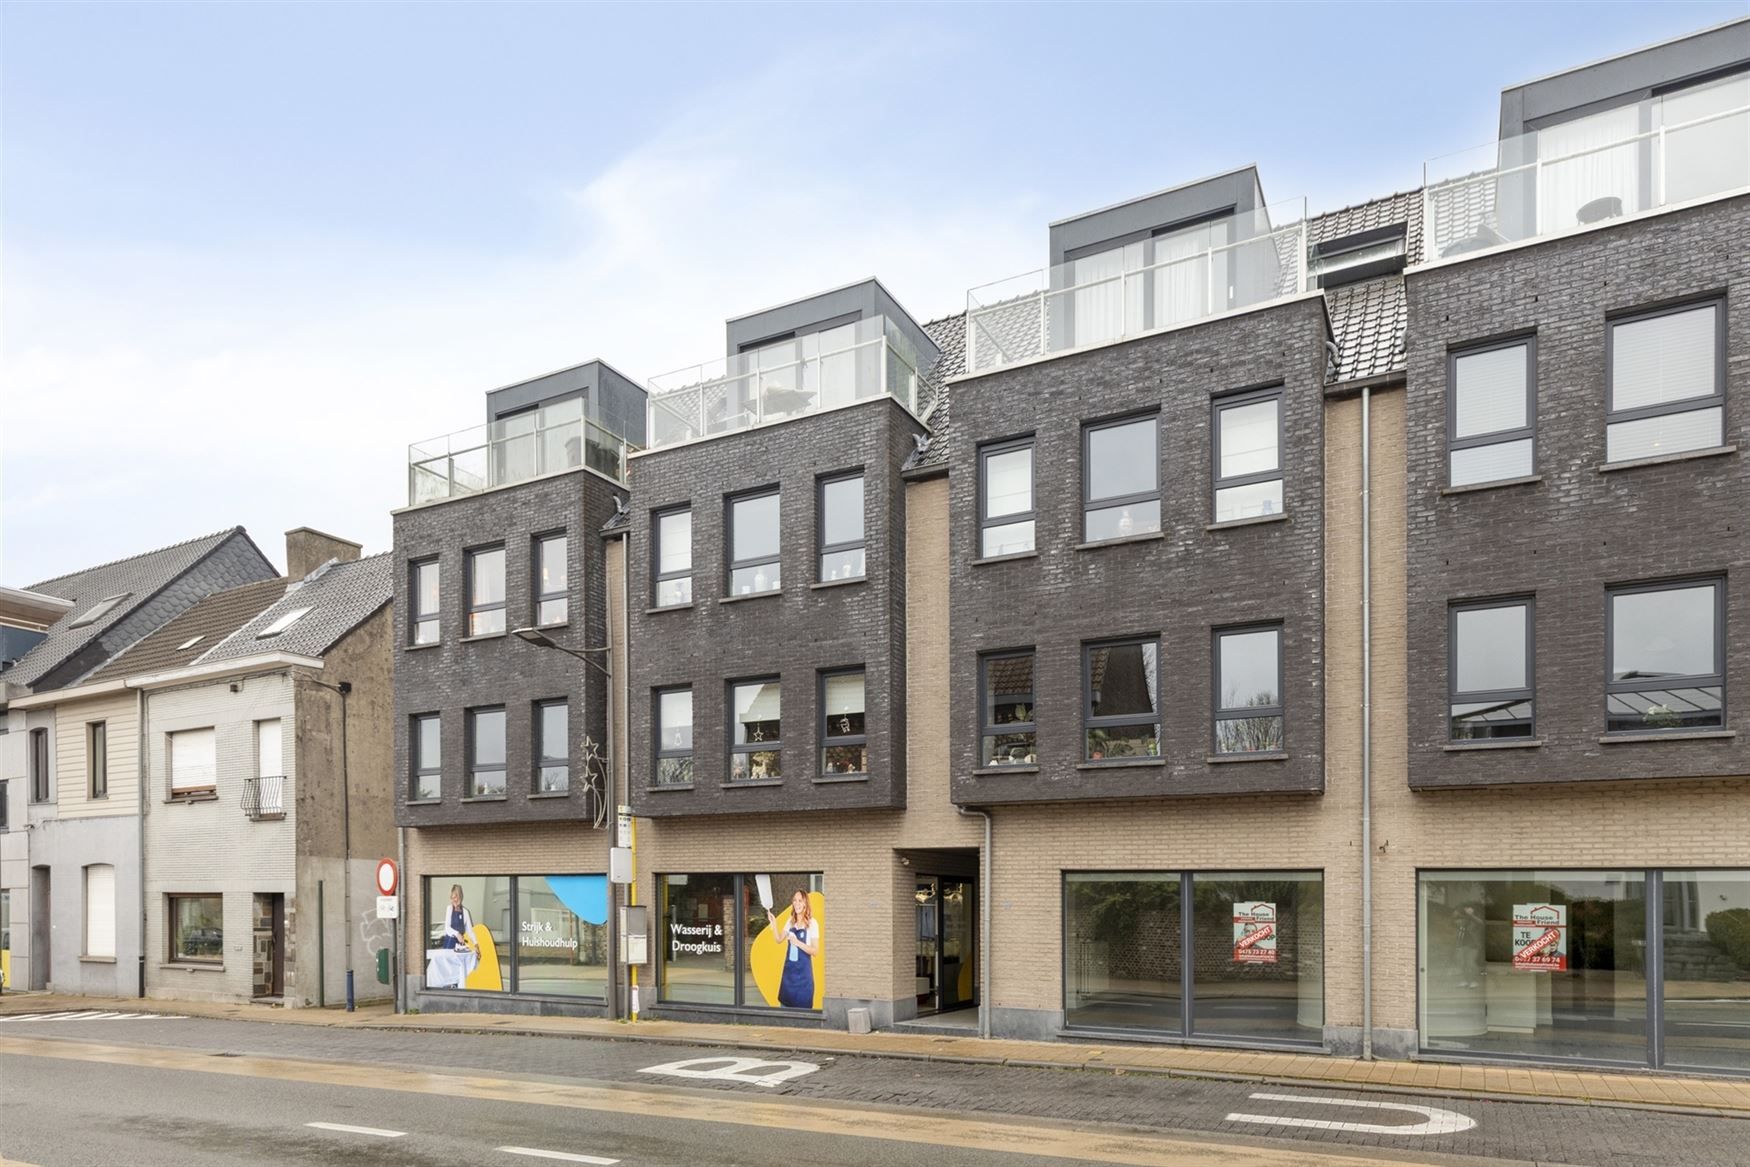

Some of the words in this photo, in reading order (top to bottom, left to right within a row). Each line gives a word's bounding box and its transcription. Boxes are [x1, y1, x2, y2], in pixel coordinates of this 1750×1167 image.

[522, 921, 543, 934] Strijk
[545, 922, 552, 931] &
[670, 924, 712, 938] Wasserij
[714, 924, 723, 936] &
[522, 936, 578, 951] Huishoudhulp
[1239, 926, 1271, 948] VERKOCHT
[1520, 930, 1556, 958] VERKOCHT
[672, 940, 721, 955] Droogkuis
